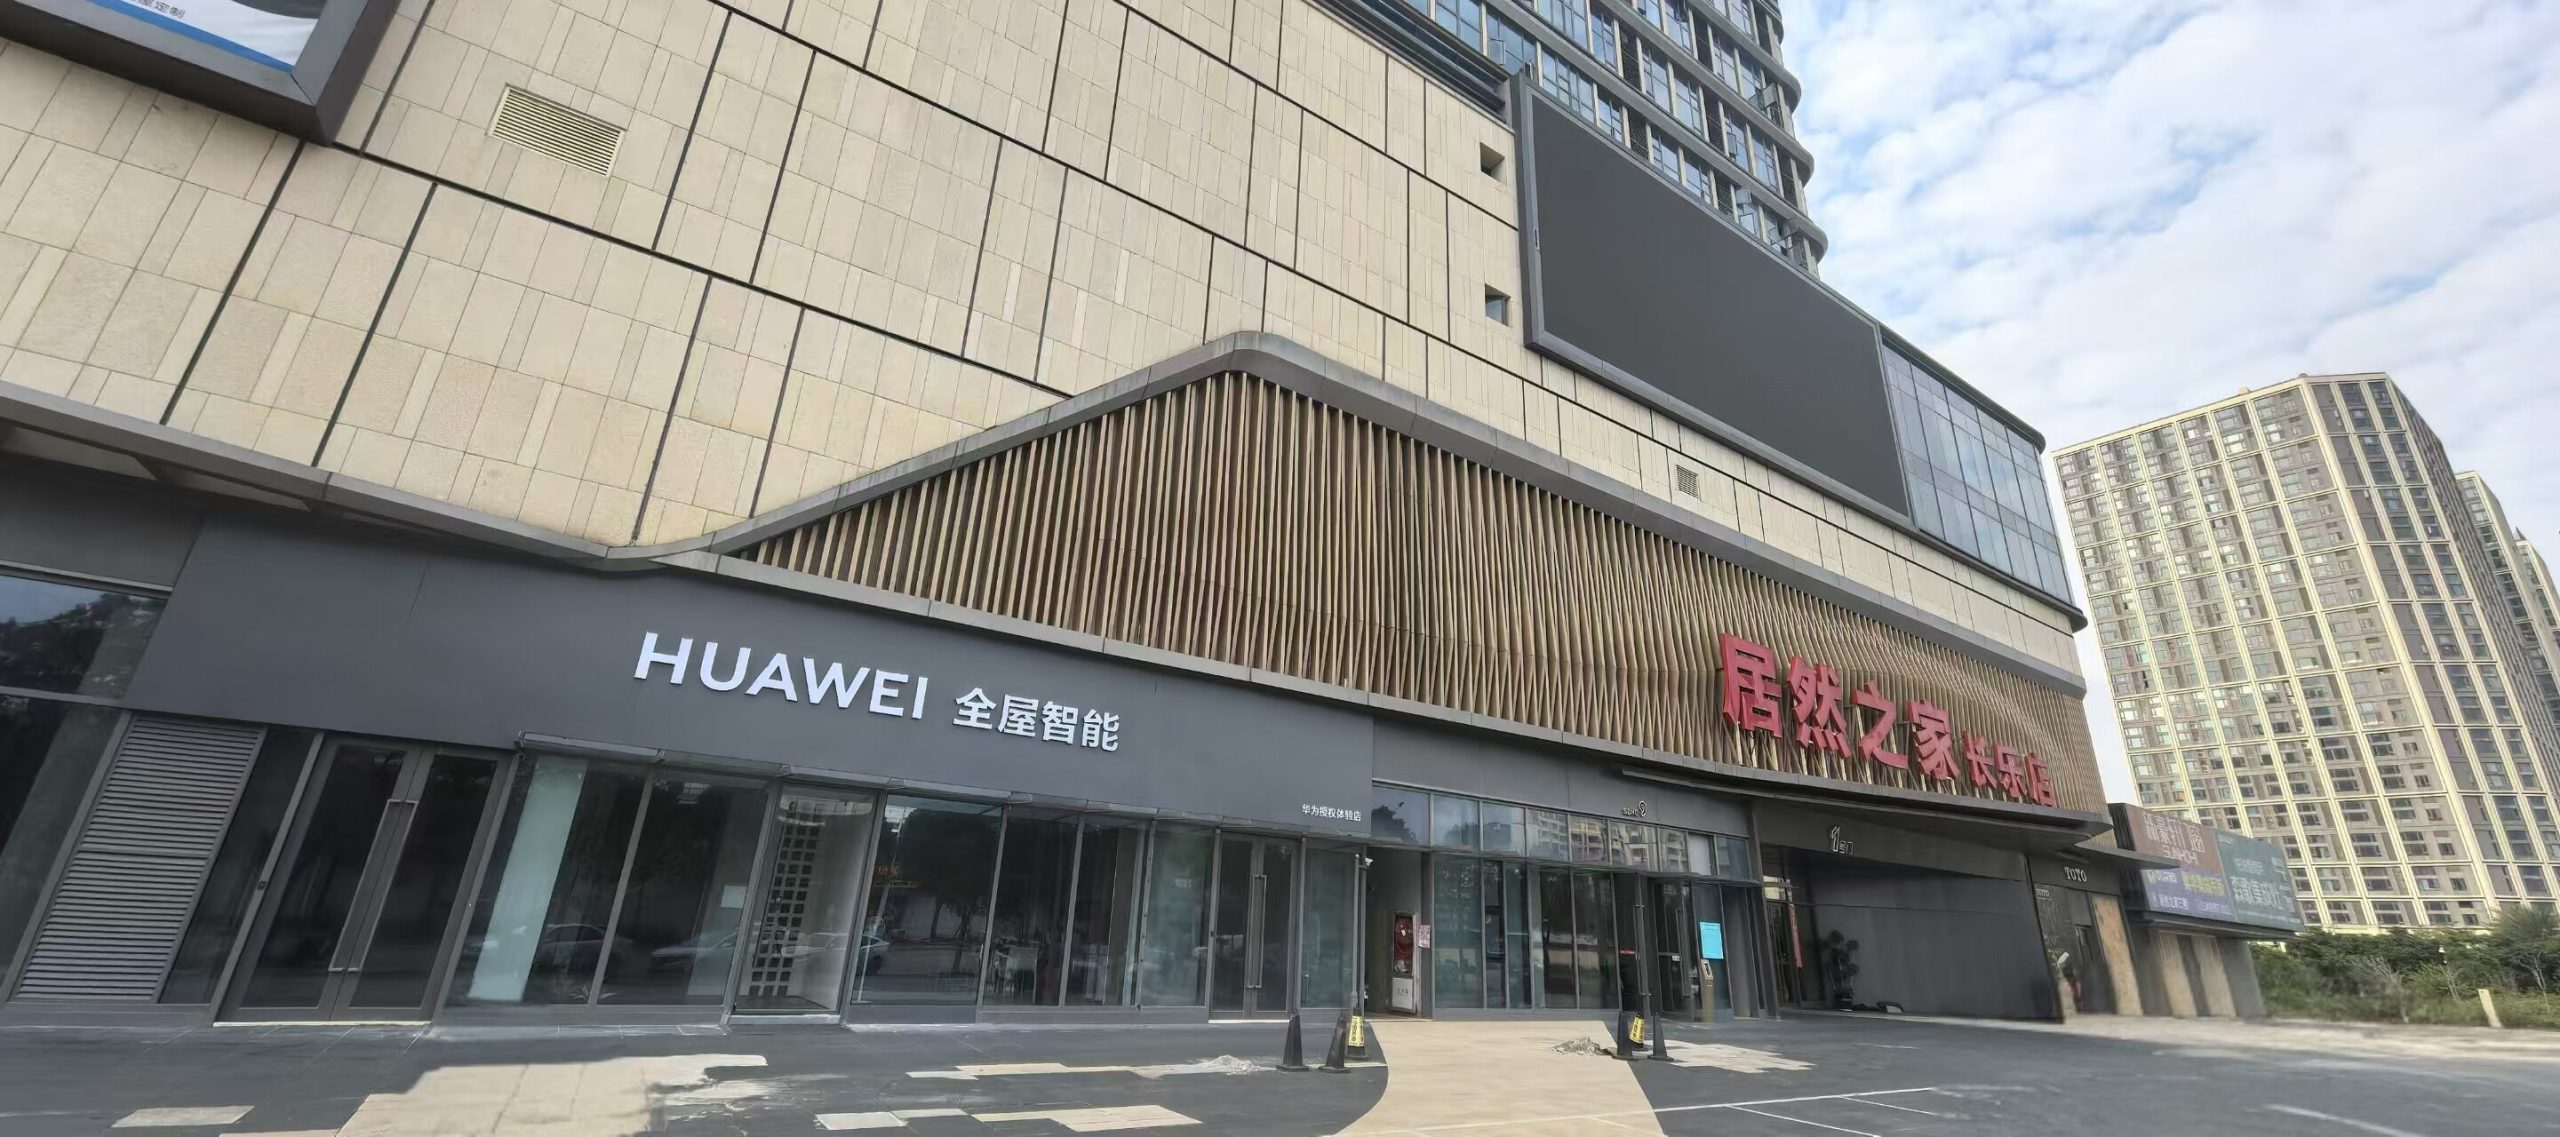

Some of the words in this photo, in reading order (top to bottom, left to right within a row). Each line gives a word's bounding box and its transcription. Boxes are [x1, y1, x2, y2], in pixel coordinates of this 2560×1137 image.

[634, 631, 929, 719] HUAWEI
[953, 687, 1121, 752] 全屋智能
[1720, 632, 1961, 780] 居然之家
[1963, 731, 2057, 807] 长乐店
[1302, 803, 1361, 822] 华为授权体验店
[2064, 866, 2088, 882] TOTO
